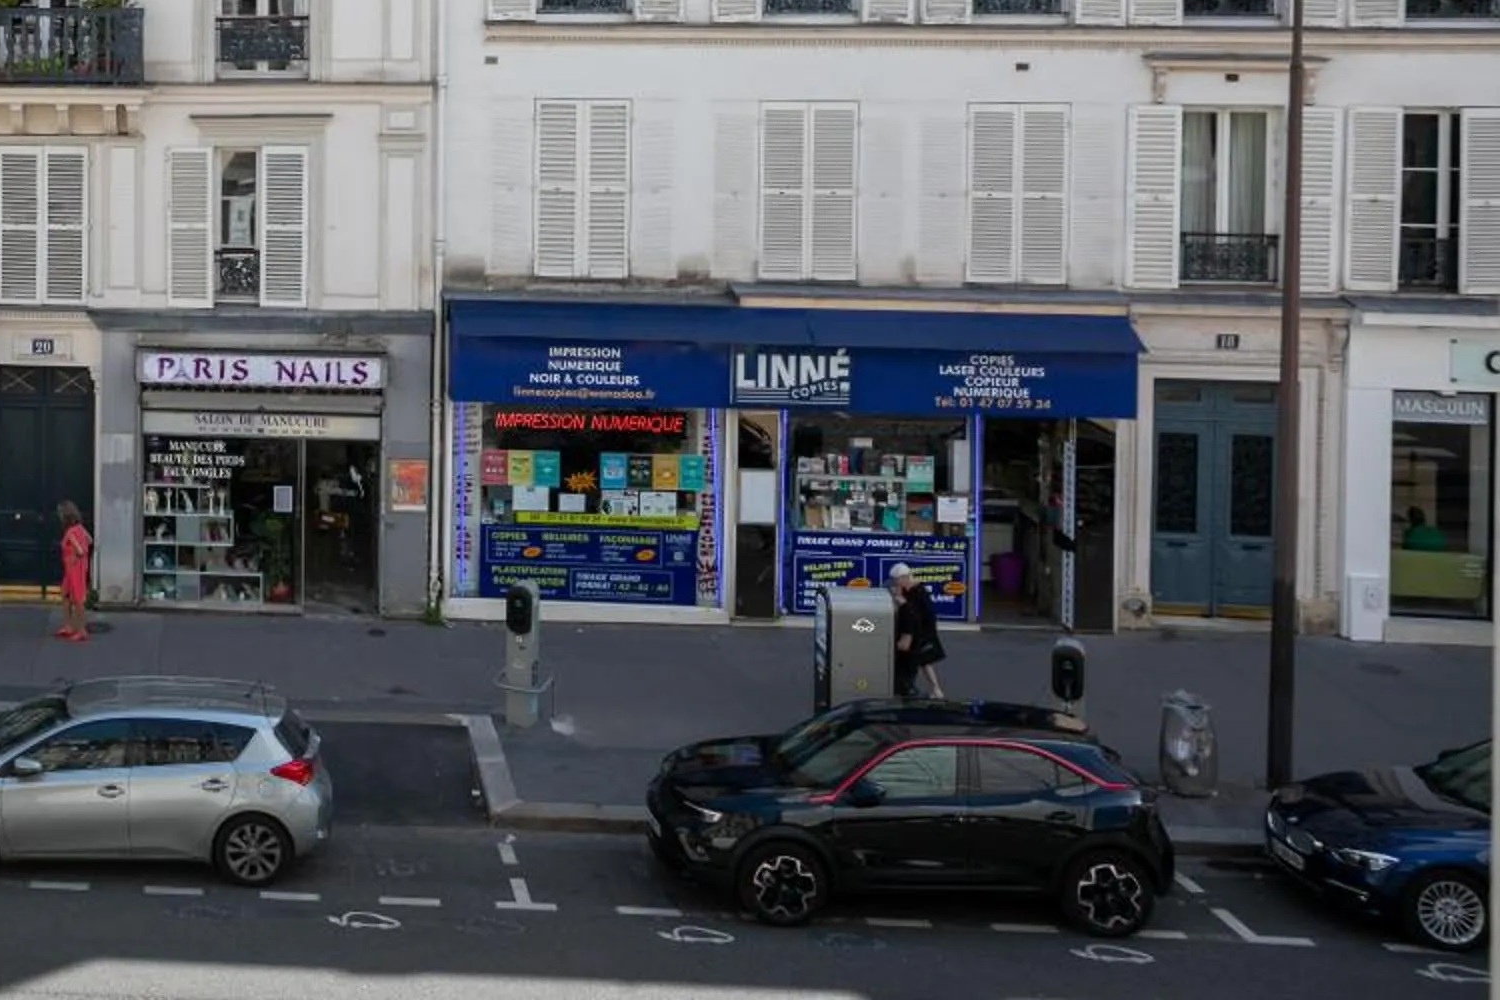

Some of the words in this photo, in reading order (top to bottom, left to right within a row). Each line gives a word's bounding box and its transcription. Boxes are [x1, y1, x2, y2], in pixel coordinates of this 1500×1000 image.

[35, 341, 51, 353] 20
[549, 347, 621, 358] IMPRESSION
[548, 361, 622, 372] NUMERIQUE
[970, 355, 1015, 366] COPIES
[276, 360, 369, 384] NAILS
[736, 348, 850, 388] LINNÉ
[939, 365, 976, 375] LASER
[980, 366, 1045, 377] COULEURS
[529, 373, 561, 384] NOIR
[564, 374, 573, 384] &
[576, 374, 640, 385] COULEURS
[965, 376, 1019, 387] COPIEUR
[791, 380, 838, 399] COPIES
[953, 387, 1030, 399] NUMERIQUE
[960, 397, 974, 408] 01
[978, 397, 993, 408] 47
[1395, 398, 1485, 416] MASCULIN
[195, 415, 234, 426] SALON
[239, 415, 252, 426] DE
[495, 412, 585, 430] IMPRESSION
[591, 414, 684, 433] NUMERIQUE
[193, 455, 213, 465] DES
[191, 467, 233, 479] ONGLES
